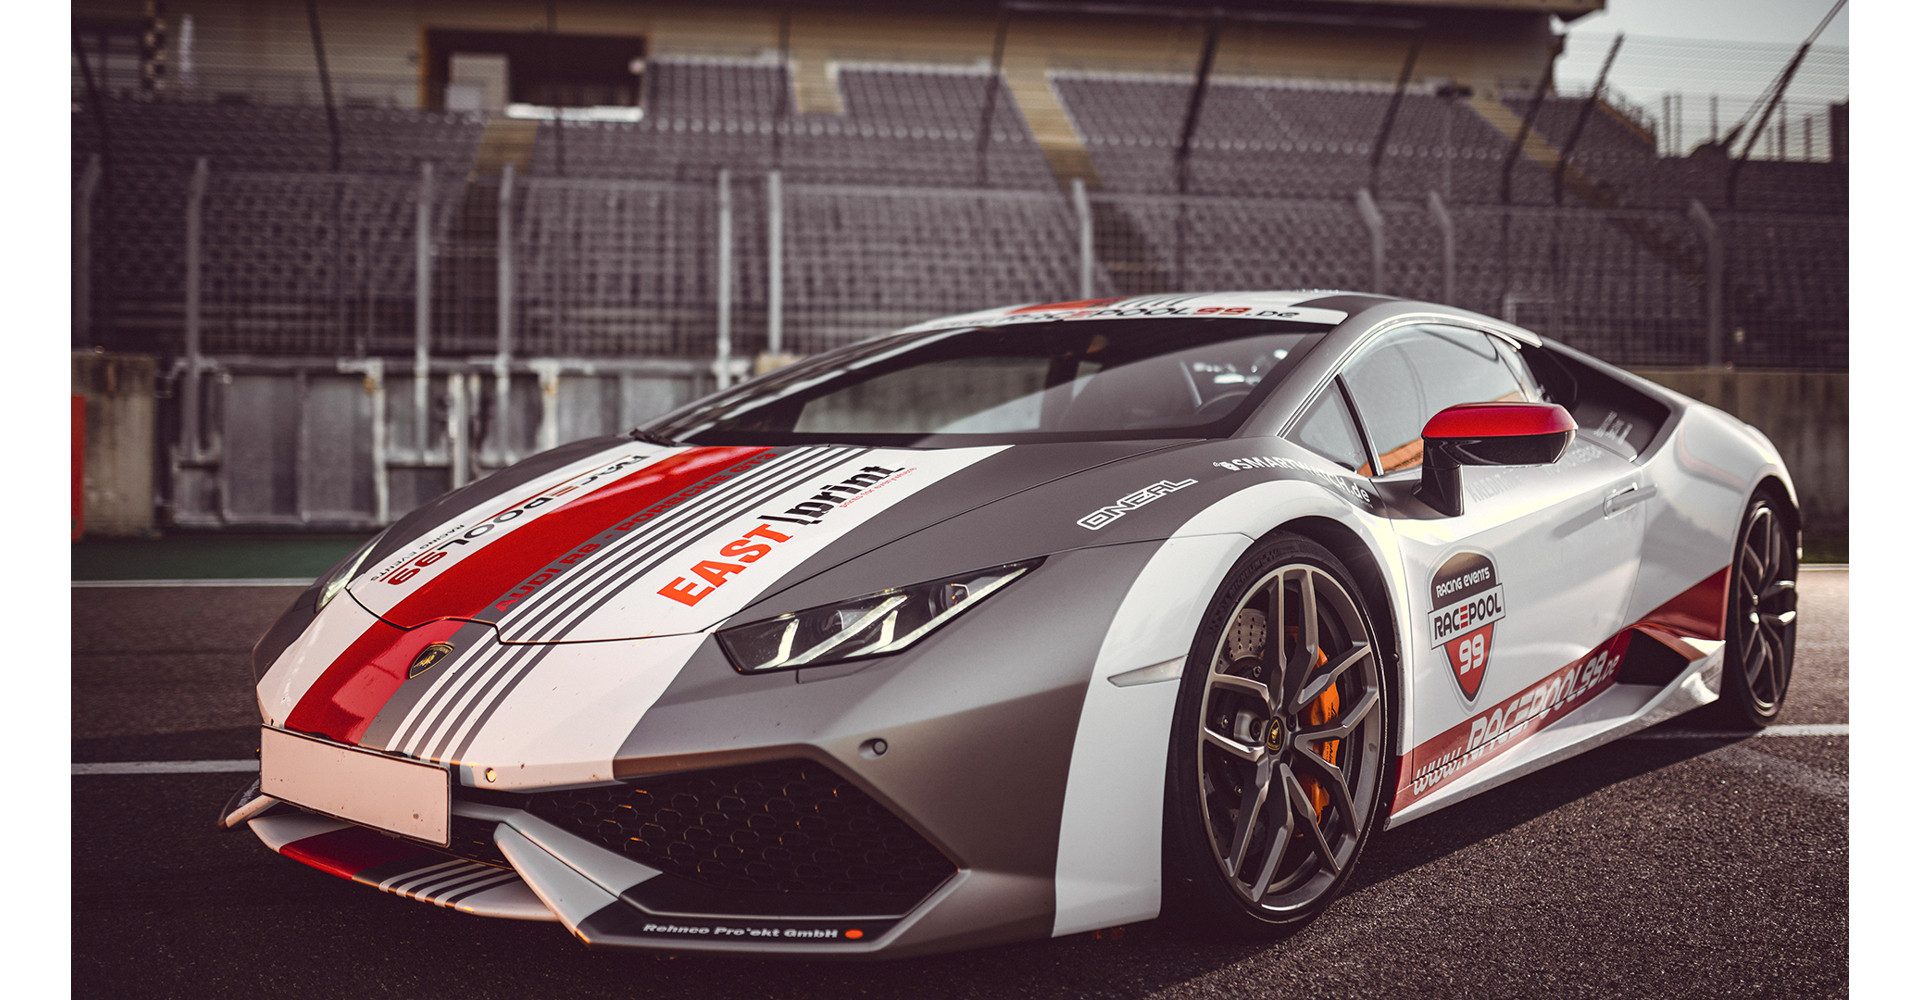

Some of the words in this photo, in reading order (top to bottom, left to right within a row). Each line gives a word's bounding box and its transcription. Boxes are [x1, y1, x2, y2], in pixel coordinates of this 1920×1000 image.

[495, 565, 563, 612] AUDI
[656, 523, 794, 607] EAST
[1434, 592, 1502, 641] RACEPOOL
[1458, 633, 1485, 676] 99
[784, 927, 839, 939] GmbH
